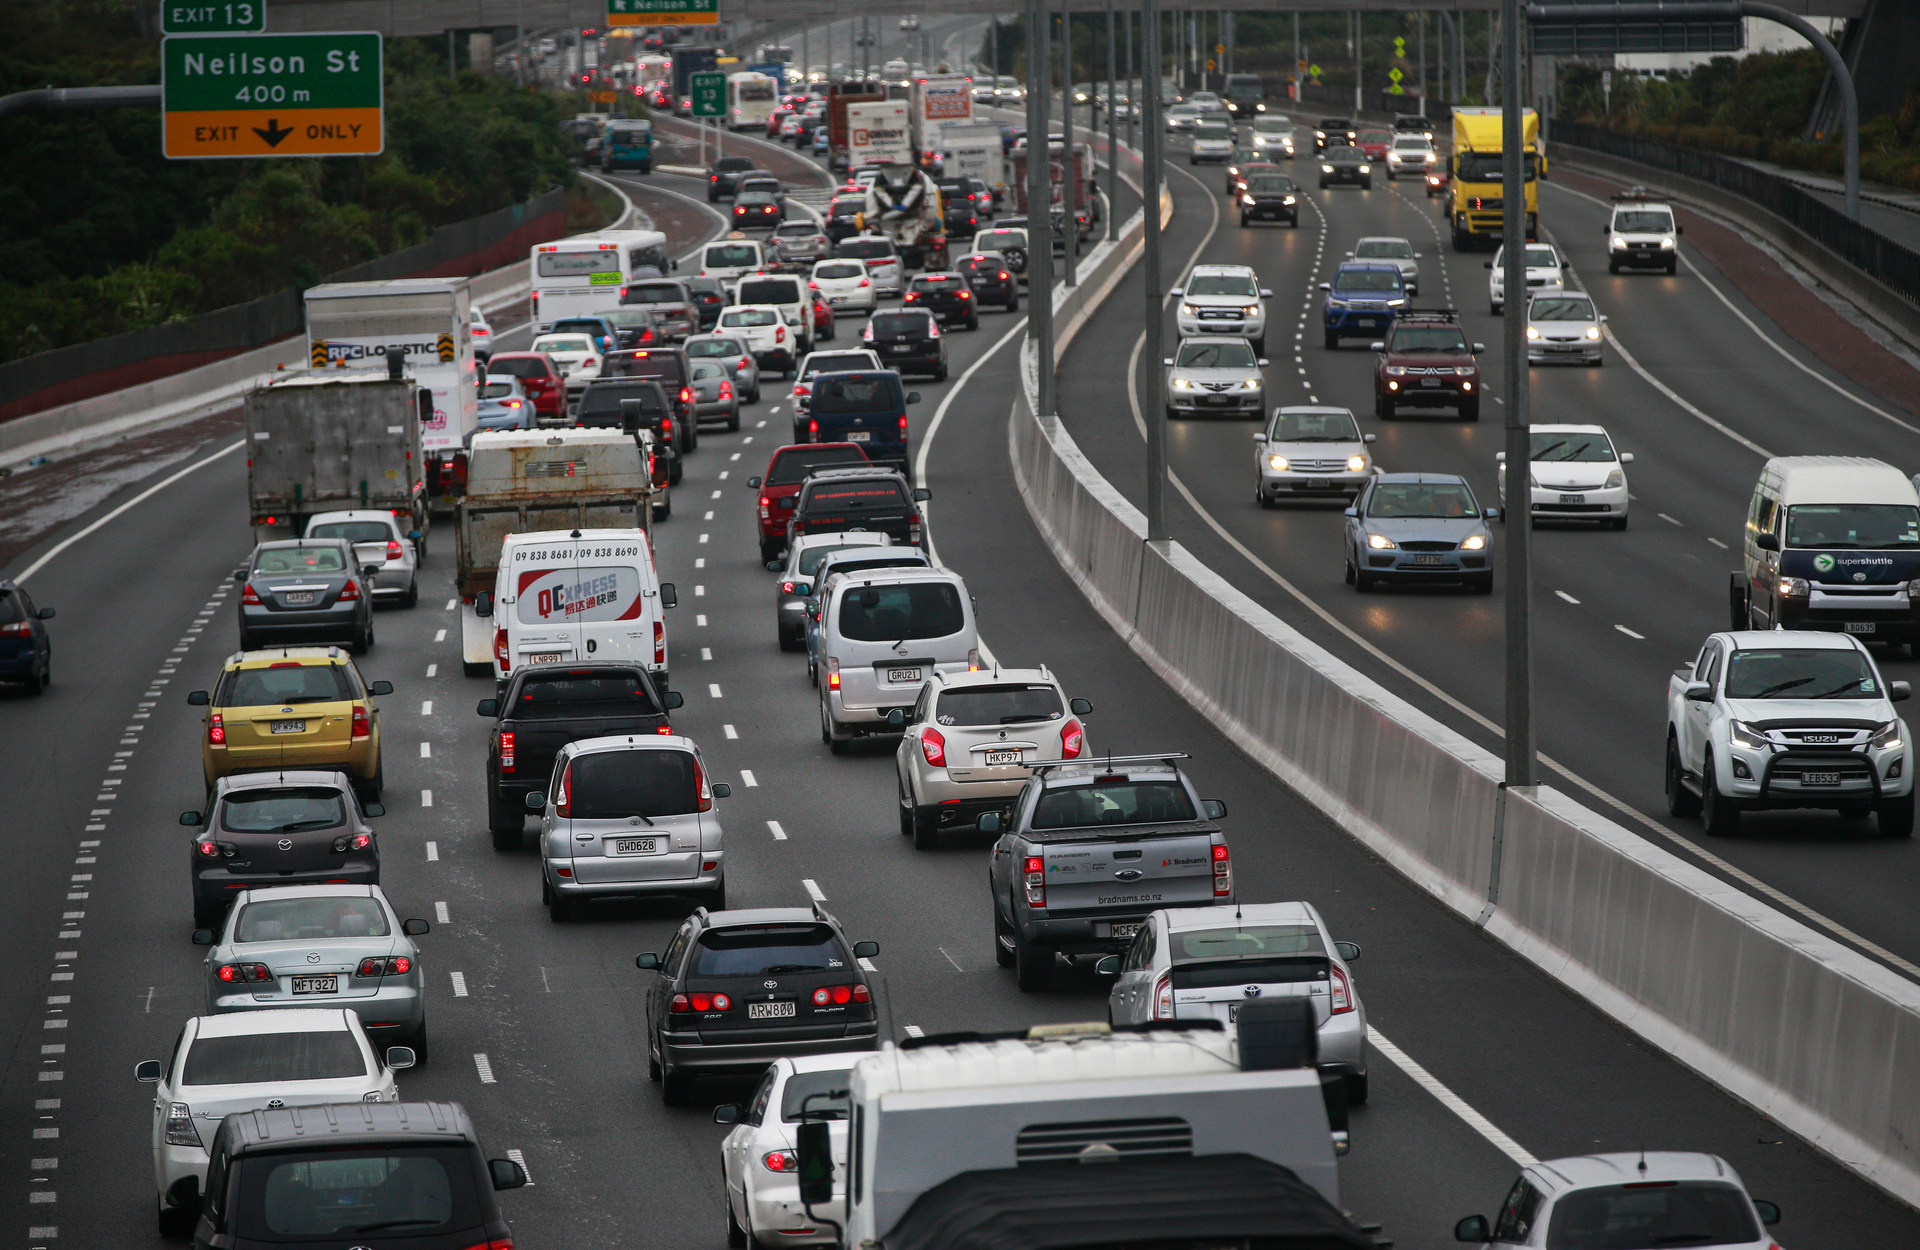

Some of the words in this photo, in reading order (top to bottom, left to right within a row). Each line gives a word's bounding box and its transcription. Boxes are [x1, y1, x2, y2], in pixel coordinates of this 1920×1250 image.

[634, 0, 687, 9] Neilson
[695, 0, 710, 9] St
[172, 8, 216, 22] EXIT
[224, 4, 254, 25] 13
[184, 52, 305, 75] Neilson
[326, 50, 360, 73] St
[695, 77, 721, 86] EXIT
[235, 85, 286, 102] 400
[293, 89, 311, 101] m
[702, 89, 717, 100] 13
[195, 126, 239, 141] EXIT
[306, 124, 362, 139] ONLY
[328, 345, 363, 359] RPC
[515, 552, 527, 561] 09
[530, 551, 547, 560] 838
[594, 547, 612, 557] 838
[615, 547, 638, 556] 8690
[1837, 558, 1893, 566] supershuttle
[565, 590, 617, 616] 易达通快递
[533, 655, 558, 664] LNR99
[892, 671, 916, 680] GRU21
[989, 753, 1018, 762] HKP97
[1803, 773, 1840, 783] LEB533
[618, 840, 654, 851] GWD628
[1174, 857, 1207, 866] Bradnam's
[1098, 893, 1162, 905] bradnams.co.nz
[1112, 924, 1142, 936] MCF6
[294, 979, 335, 991] MFT327
[750, 1004, 794, 1018] ARW800
